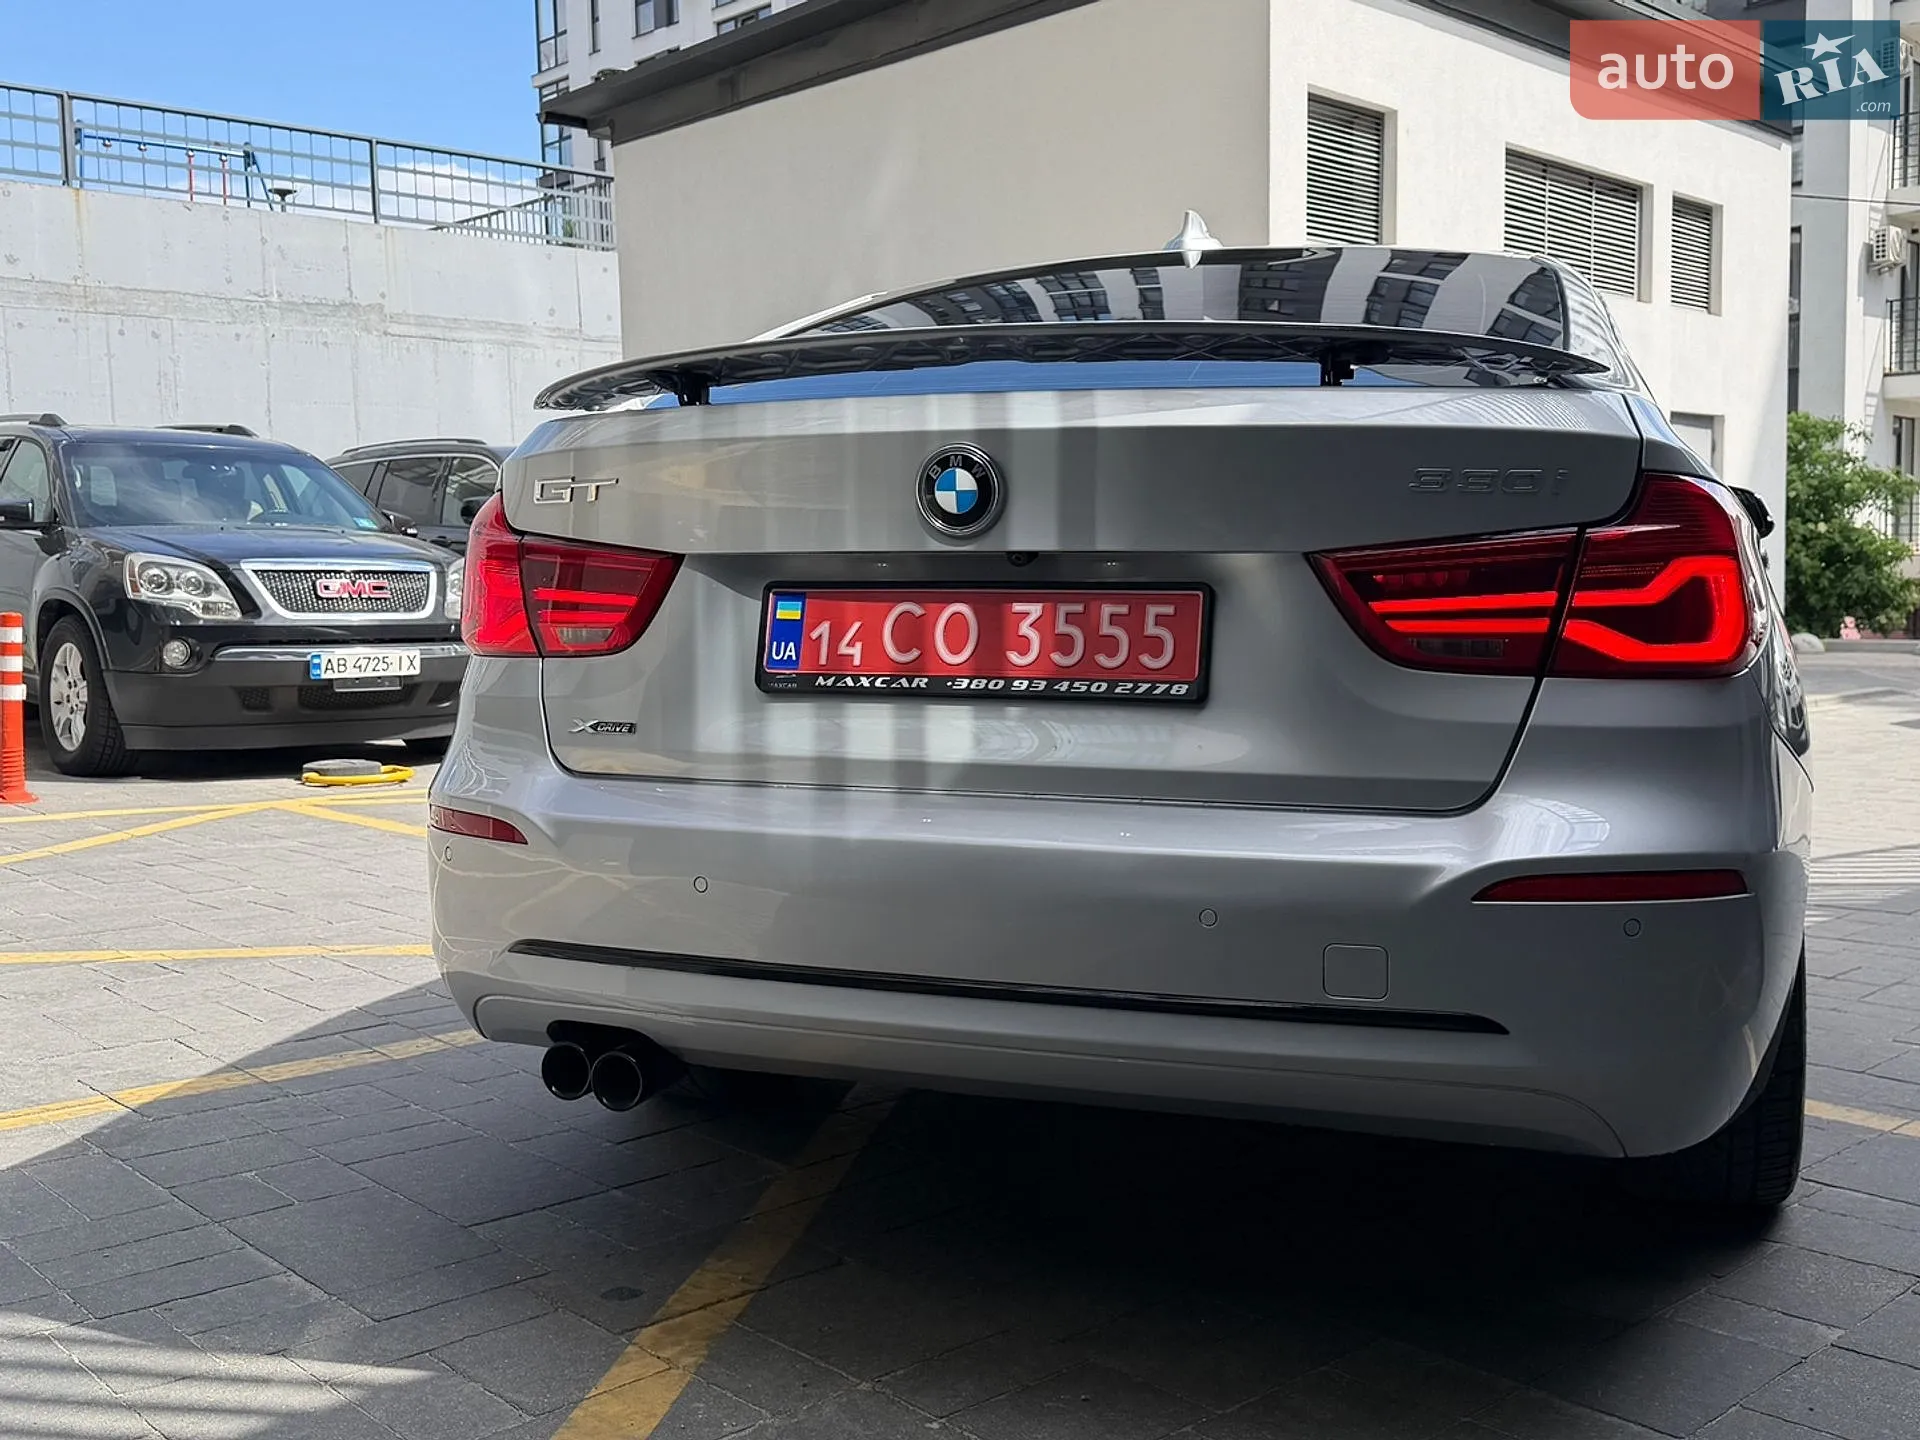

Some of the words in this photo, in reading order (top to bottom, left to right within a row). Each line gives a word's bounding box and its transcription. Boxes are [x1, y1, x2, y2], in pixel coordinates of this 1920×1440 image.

[928, 455, 986, 480] BMW
[533, 477, 619, 504] GT
[317, 579, 392, 598] GMC
[809, 620, 864, 667] 14
[882, 601, 979, 665] CO
[1005, 602, 1176, 670] 3555
[772, 641, 797, 660] UA
[324, 658, 348, 674] AB
[353, 656, 390, 672] 4725
[815, 676, 929, 689] MAXCAR
[1011, 679, 1047, 692] 93
[1053, 681, 1108, 693] 450
[1114, 683, 1190, 695] 2778
